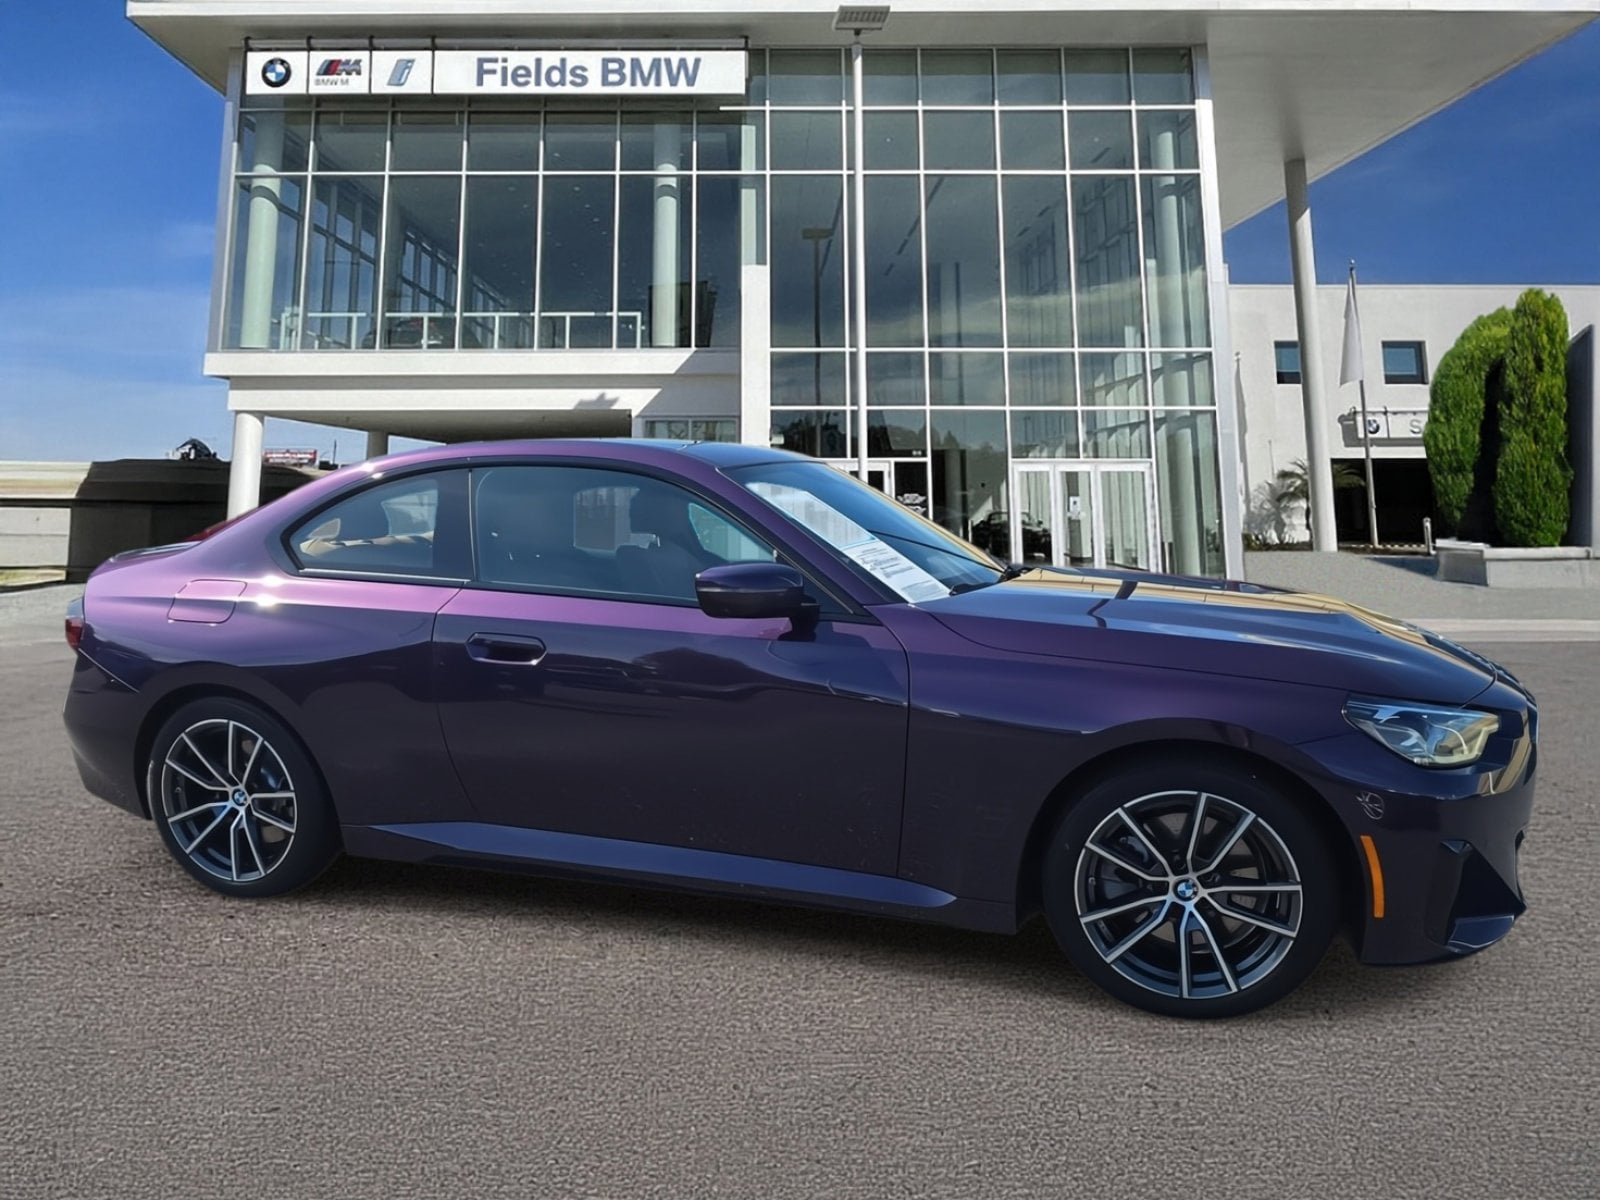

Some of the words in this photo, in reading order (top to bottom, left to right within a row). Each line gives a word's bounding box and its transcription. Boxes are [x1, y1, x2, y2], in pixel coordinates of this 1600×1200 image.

[476, 57, 589, 87] Fields
[601, 57, 702, 87] BMW
[314, 78, 338, 86] BMW
